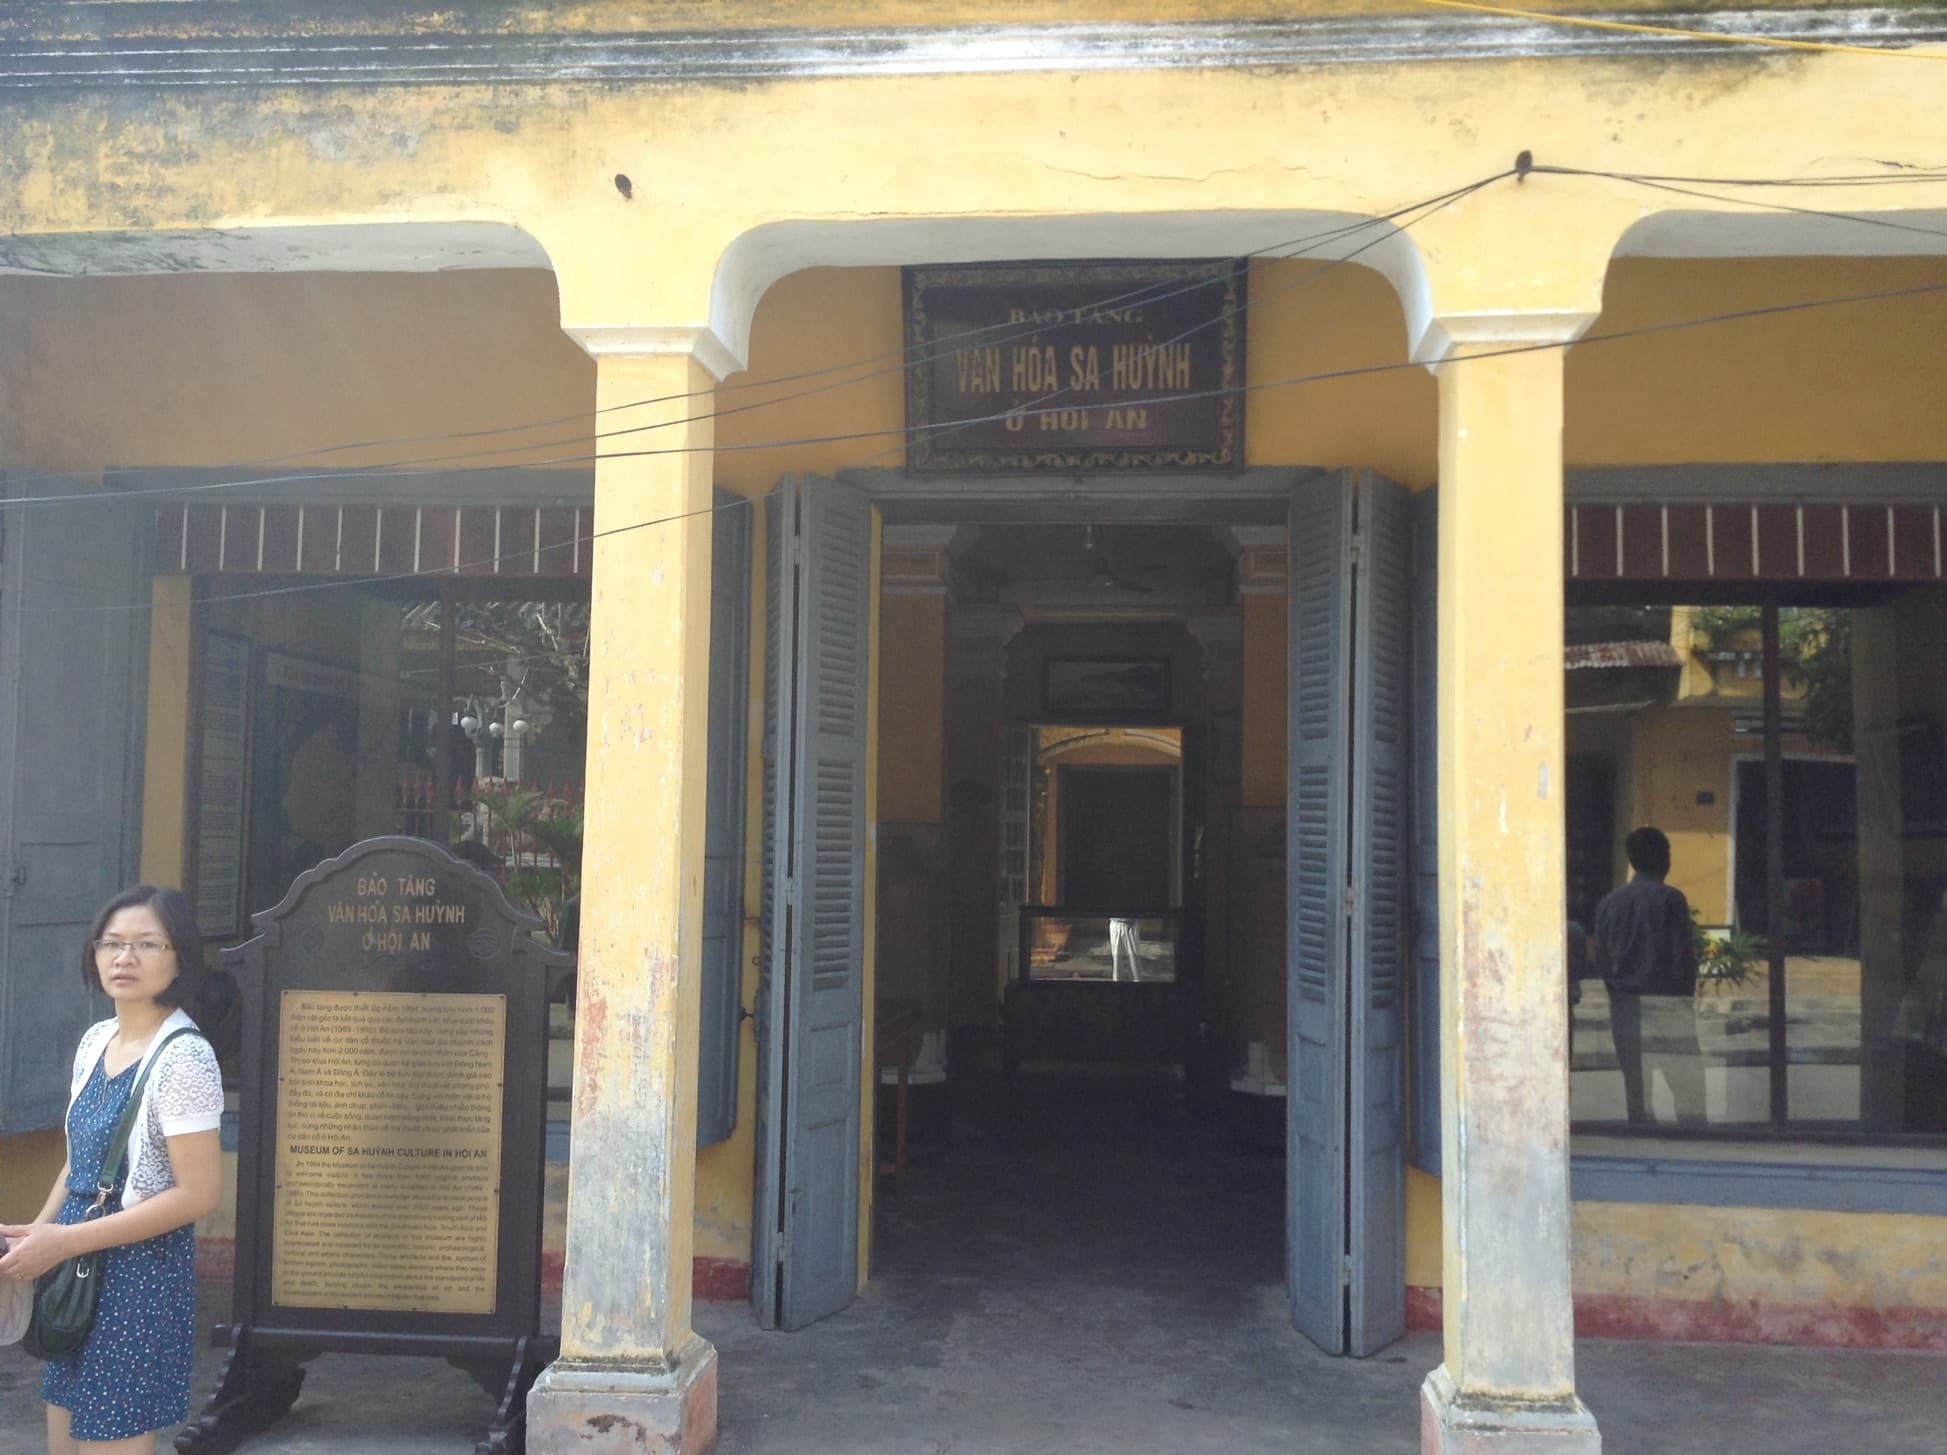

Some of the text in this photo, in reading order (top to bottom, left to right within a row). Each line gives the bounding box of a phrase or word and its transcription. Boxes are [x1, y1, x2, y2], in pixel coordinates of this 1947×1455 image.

[1070, 345, 1099, 391] SA
[1112, 333, 1190, 390] HUỲNH
[1105, 408, 1147, 430] AN
[398, 874, 436, 896] TÀNG
[392, 905, 411, 924] SA
[415, 899, 466, 924] HUỲNH
[409, 932, 432, 951] AN
[290, 1145, 330, 1154] MUSEUM
[332, 1146, 345, 1155] OF
[347, 1147, 360, 1156] SA
[396, 1148, 440, 1158] CULTURE
[442, 1149, 453, 1157] IN
[473, 1149, 488, 1158] AN
